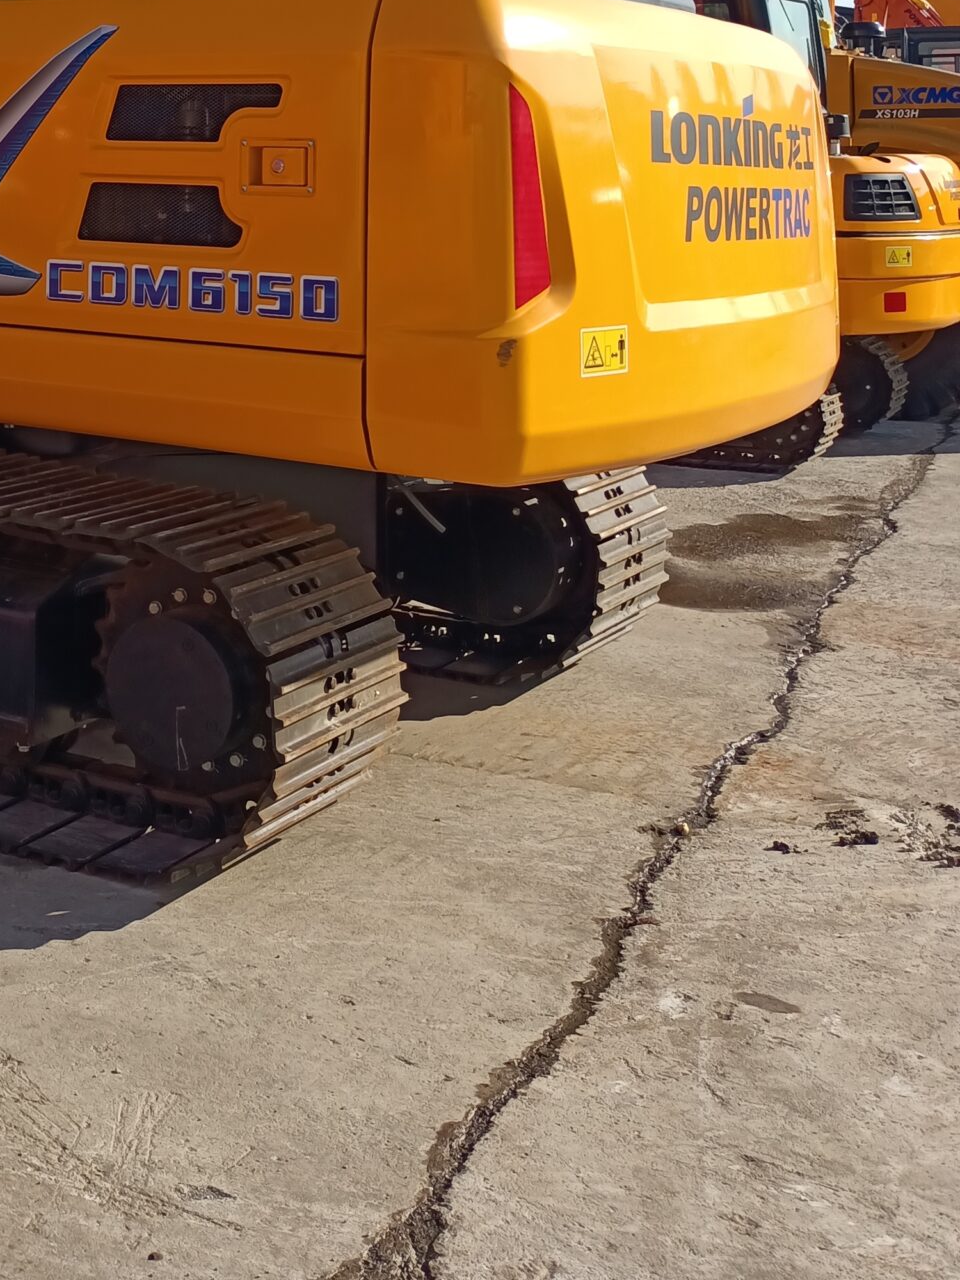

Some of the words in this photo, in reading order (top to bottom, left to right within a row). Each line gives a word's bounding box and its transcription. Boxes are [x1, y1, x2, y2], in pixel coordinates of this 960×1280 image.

[875, 108, 920, 119] XS103H
[894, 86, 960, 105] XCMG
[684, 185, 811, 243] POWERTRAC
[45, 258, 339, 322] CDM6150
